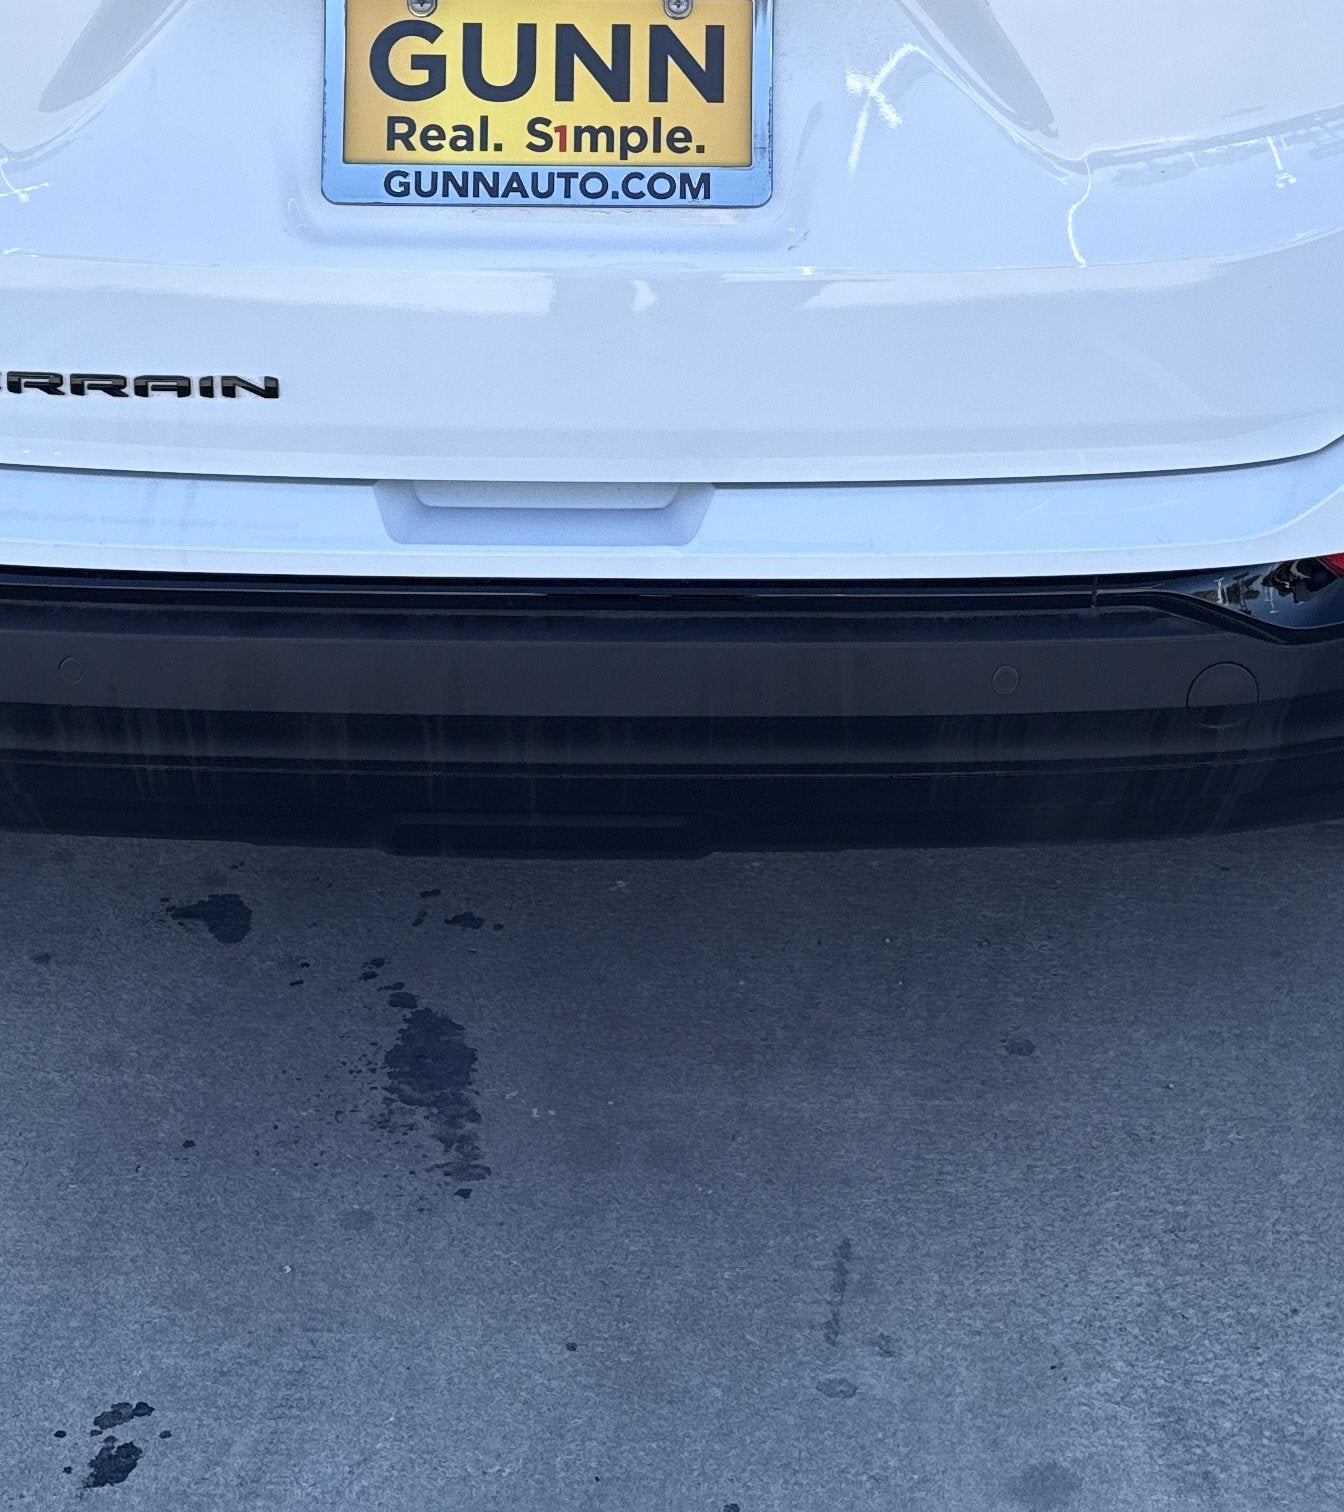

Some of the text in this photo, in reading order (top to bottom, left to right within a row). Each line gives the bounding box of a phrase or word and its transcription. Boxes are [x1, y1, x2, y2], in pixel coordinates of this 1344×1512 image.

[369, 19, 725, 104] GUNN
[386, 115, 503, 153] Real.
[383, 170, 711, 201] GUNNAUTO.COM
